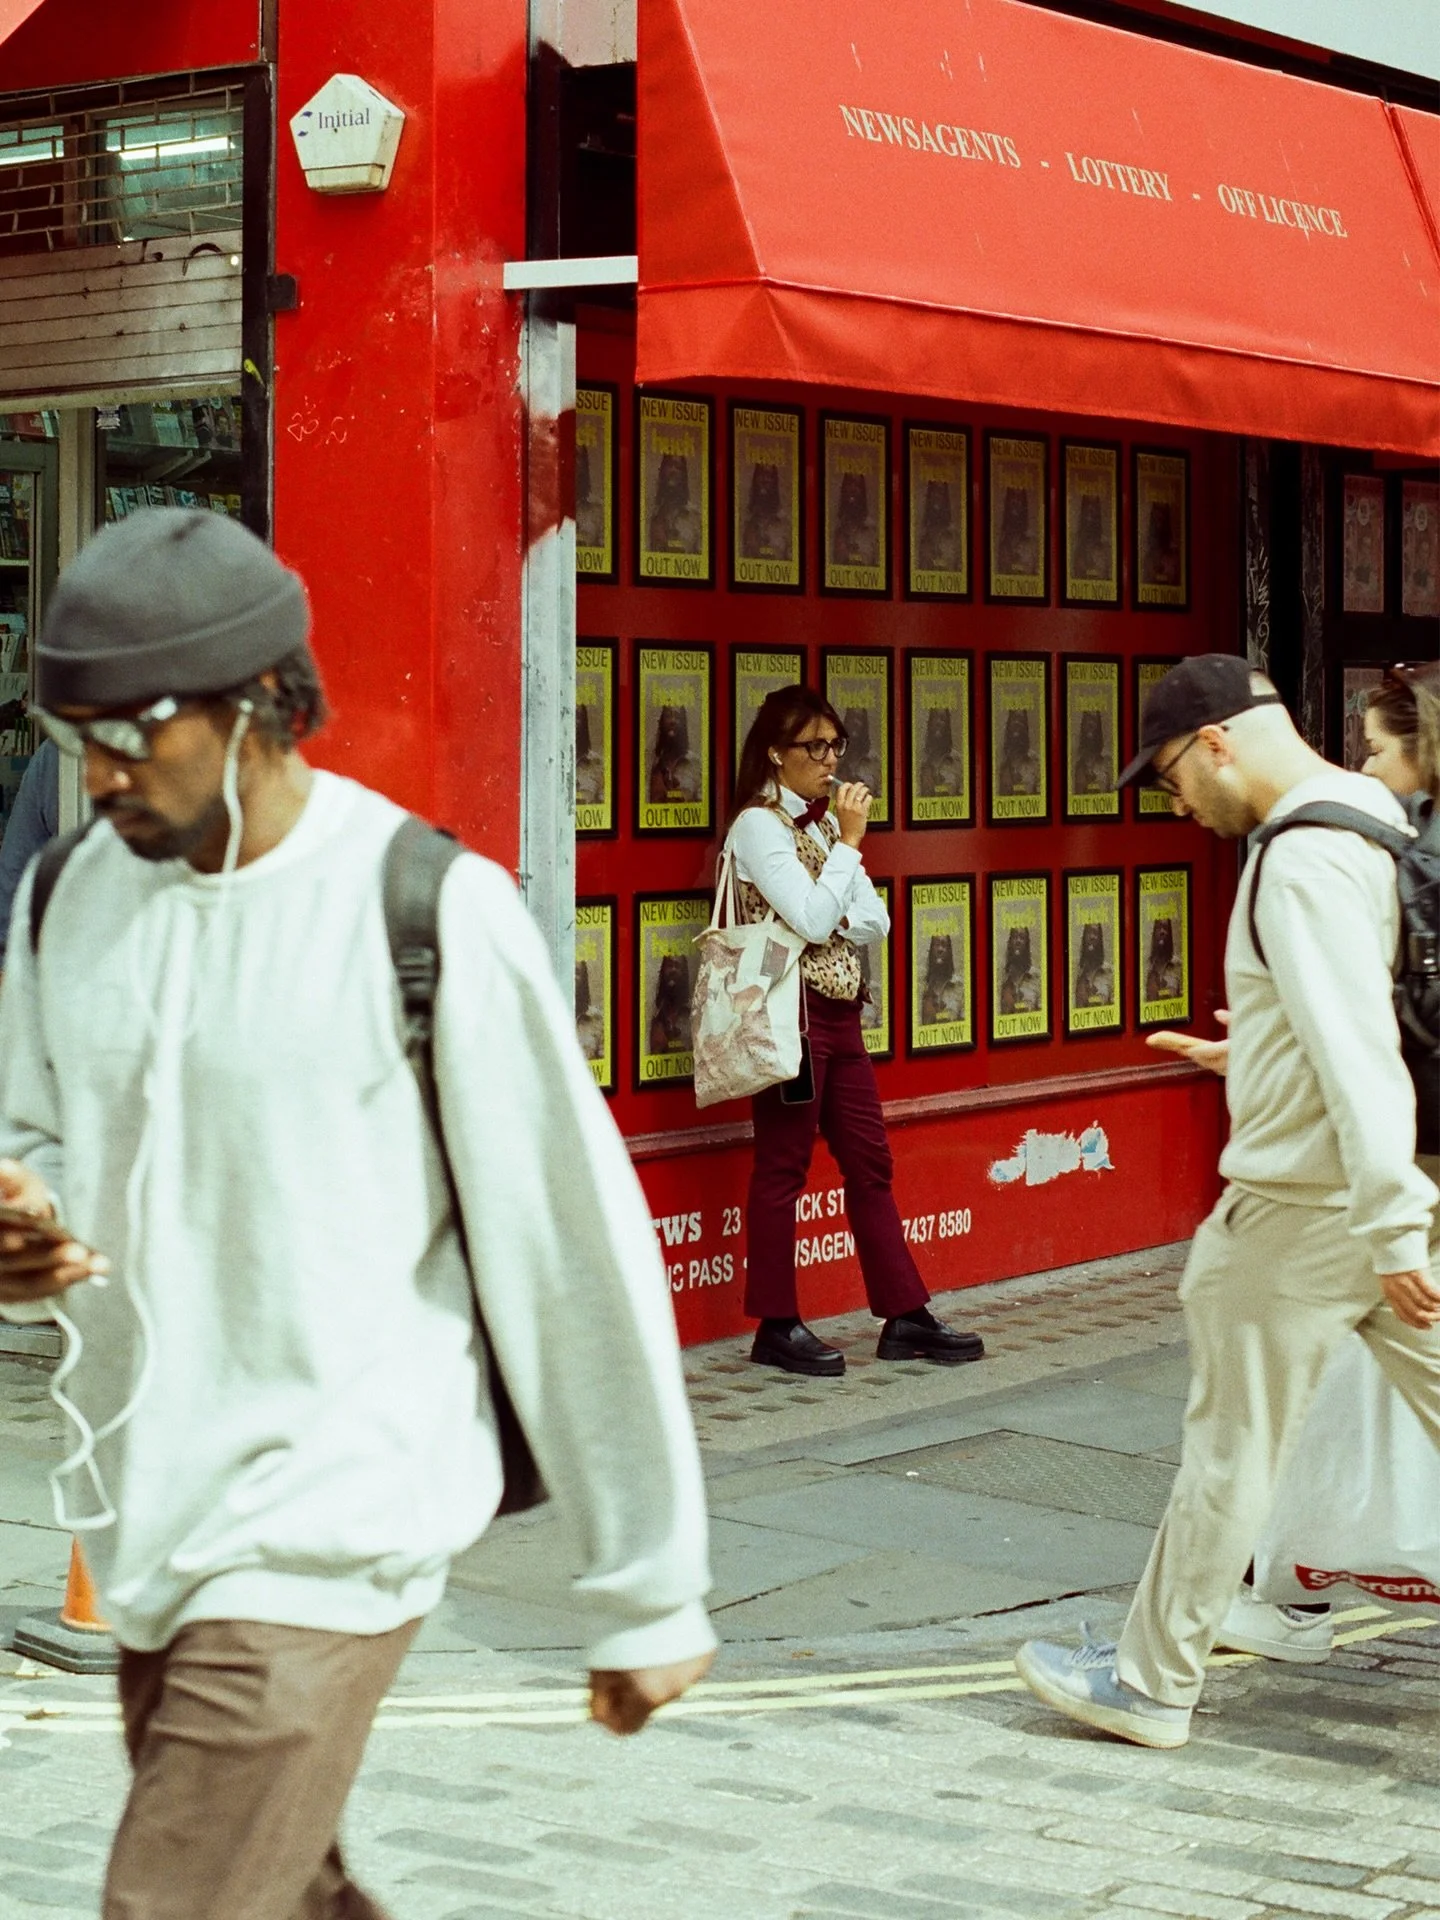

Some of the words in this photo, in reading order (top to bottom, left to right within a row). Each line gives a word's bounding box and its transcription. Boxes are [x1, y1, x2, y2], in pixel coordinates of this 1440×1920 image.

[318, 107, 371, 129] Initial
[839, 104, 1021, 169] NEWSAGENTS
[1064, 151, 1173, 201] LOTTERY
[1217, 183, 1258, 218] OFF
[1257, 192, 1349, 238] LICENCE
[576, 391, 609, 412] SSUE
[641, 398, 669, 419] NEW
[672, 402, 706, 423] ISSUE
[735, 410, 760, 430] NEW
[764, 413, 796, 433] ISSUE
[825, 421, 849, 440] NEW
[852, 424, 883, 443] ISSUE
[910, 431, 934, 449] NEW
[936, 434, 965, 451] ISSUE
[991, 439, 1013, 456] NEW
[1016, 441, 1043, 459] ISSUE
[1066, 447, 1086, 464] NEW
[1089, 450, 1114, 467] ISSUE
[576, 552, 604, 571] NOW
[646, 556, 671, 576] OUT
[673, 558, 700, 576] NOW
[739, 563, 762, 581] OUT
[765, 564, 791, 583] NOW
[830, 569, 852, 587] OUT
[854, 570, 879, 588] NOW
[915, 575, 937, 591] OUT
[939, 576, 961, 593] NOW
[994, 579, 1016, 594] OUT
[1018, 580, 1040, 596] NOW
[1071, 583, 1090, 599] OUT
[1091, 584, 1111, 601] NOW
[576, 649, 608, 668] SSUE
[642, 651, 665, 669] NEW
[671, 652, 705, 670] ISSUE
[738, 654, 761, 672] NEW
[766, 656, 797, 673] ISSUE
[828, 657, 850, 673] NEW
[854, 658, 884, 674] ISSUE
[912, 659, 935, 676] NEW
[938, 659, 966, 676] ISSUE
[992, 662, 1014, 678] NEW
[1016, 662, 1042, 678] ISSUE
[1068, 663, 1089, 679] NEW
[1091, 664, 1114, 680] ISSUE
[917, 802, 938, 818] OUT
[942, 801, 963, 817] NOW
[997, 801, 1016, 816] OUT
[1018, 800, 1040, 815] NOW
[1072, 800, 1090, 814] OUT
[1092, 799, 1113, 813] NOW
[1142, 795, 1160, 811] OUT
[1161, 795, 1173, 810] NO
[576, 809, 603, 827] NOW
[646, 808, 670, 826] OUT
[674, 808, 700, 824] NOW
[993, 881, 1014, 897] NEW
[1017, 878, 1044, 895] ISSUE
[1070, 878, 1088, 894] NEW
[1091, 876, 1116, 892] ISSUE
[1140, 875, 1157, 891] NEW
[1160, 873, 1184, 889] ISSUE
[914, 887, 936, 905] NEW
[938, 884, 967, 902] ISSUE
[576, 907, 608, 924] SSUE
[642, 904, 668, 921] NEW
[672, 902, 707, 920] ISSUE
[1073, 1012, 1092, 1029] OUT
[1094, 1010, 1114, 1026] NOW
[1144, 1005, 1161, 1021] OUT
[1164, 1002, 1182, 1017] NOW
[998, 1019, 1017, 1036] OUT
[1021, 1016, 1041, 1033] NOW
[865, 1034, 882, 1049] OW
[918, 1030, 939, 1047] OUT
[942, 1026, 964, 1043] NOW
[646, 1059, 672, 1078] OUT
[675, 1057, 694, 1075] NO
[722, 1206, 741, 1236] 23
[796, 1192, 823, 1223] ICK
[902, 1211, 935, 1243] 7437
[939, 1208, 971, 1238] 8580
[689, 1253, 734, 1289] PASS
[795, 1231, 855, 1268] SAGEN
